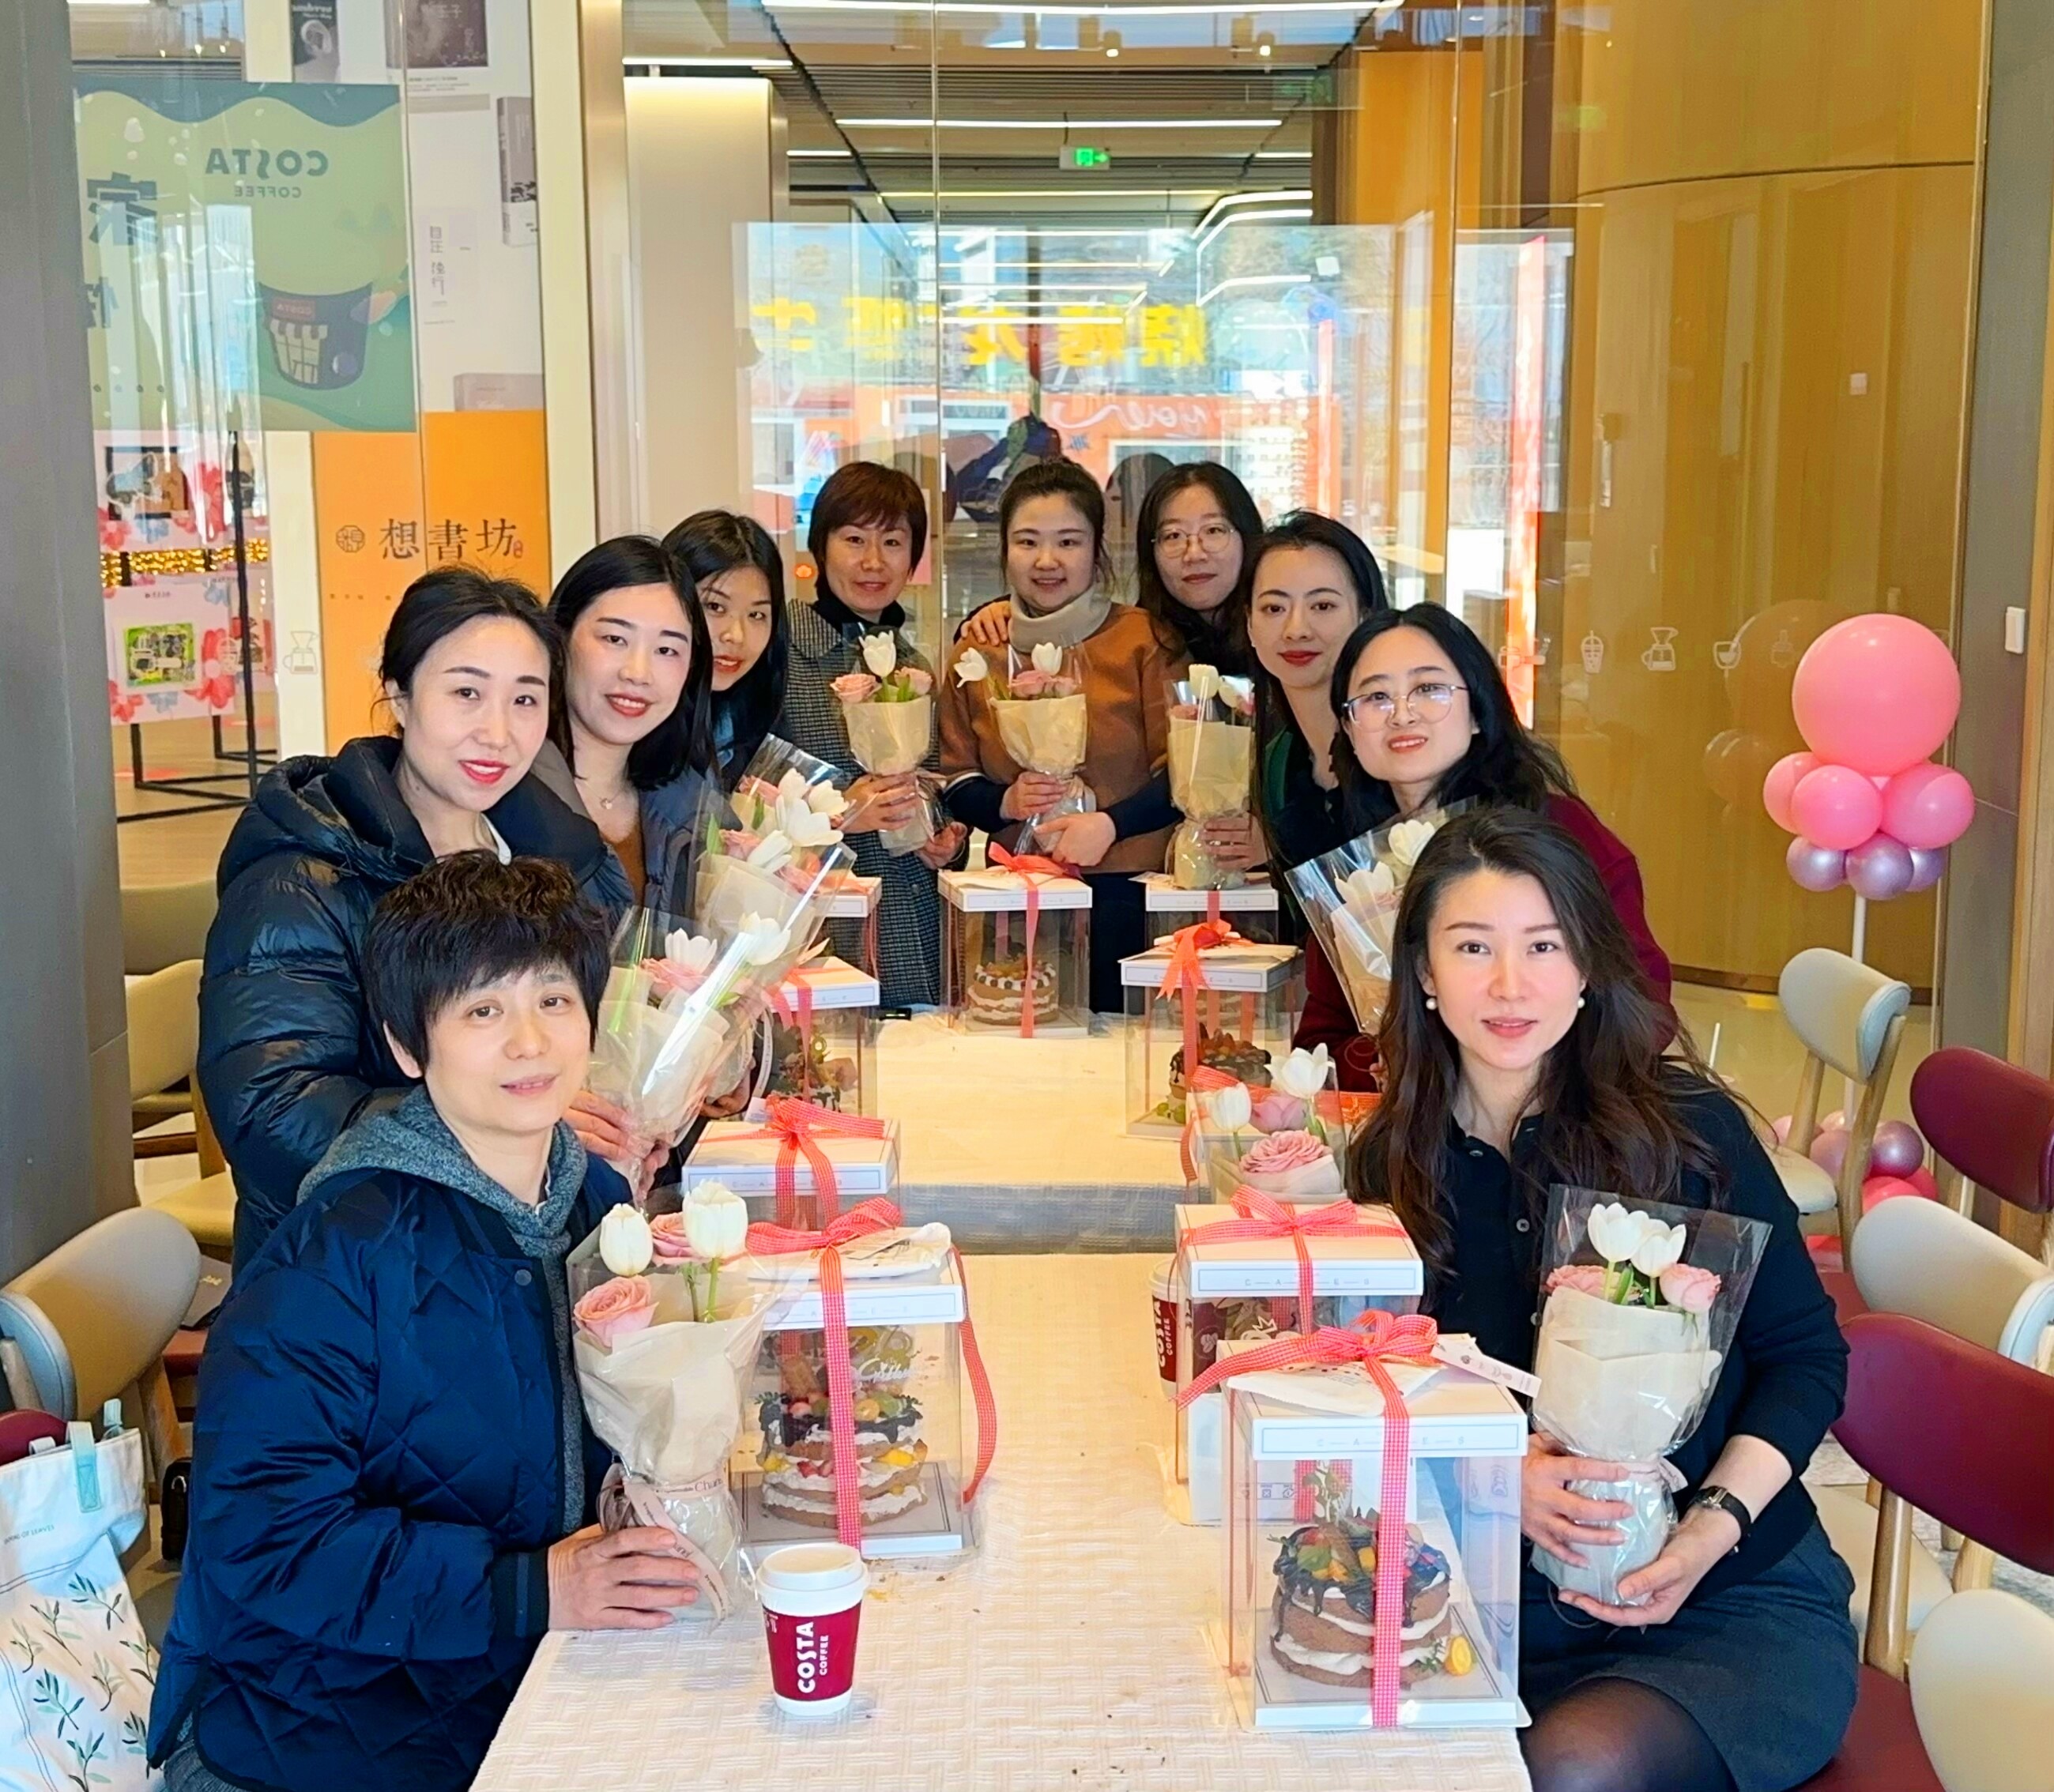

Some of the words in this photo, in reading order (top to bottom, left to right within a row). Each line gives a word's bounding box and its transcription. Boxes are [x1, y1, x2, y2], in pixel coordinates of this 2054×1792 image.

[379, 518, 517, 562] 想書坊
[1163, 1317, 1174, 1356] COFFEE
[796, 1621, 817, 1693] COSTA
[819, 1635, 829, 1676] COFFEE
